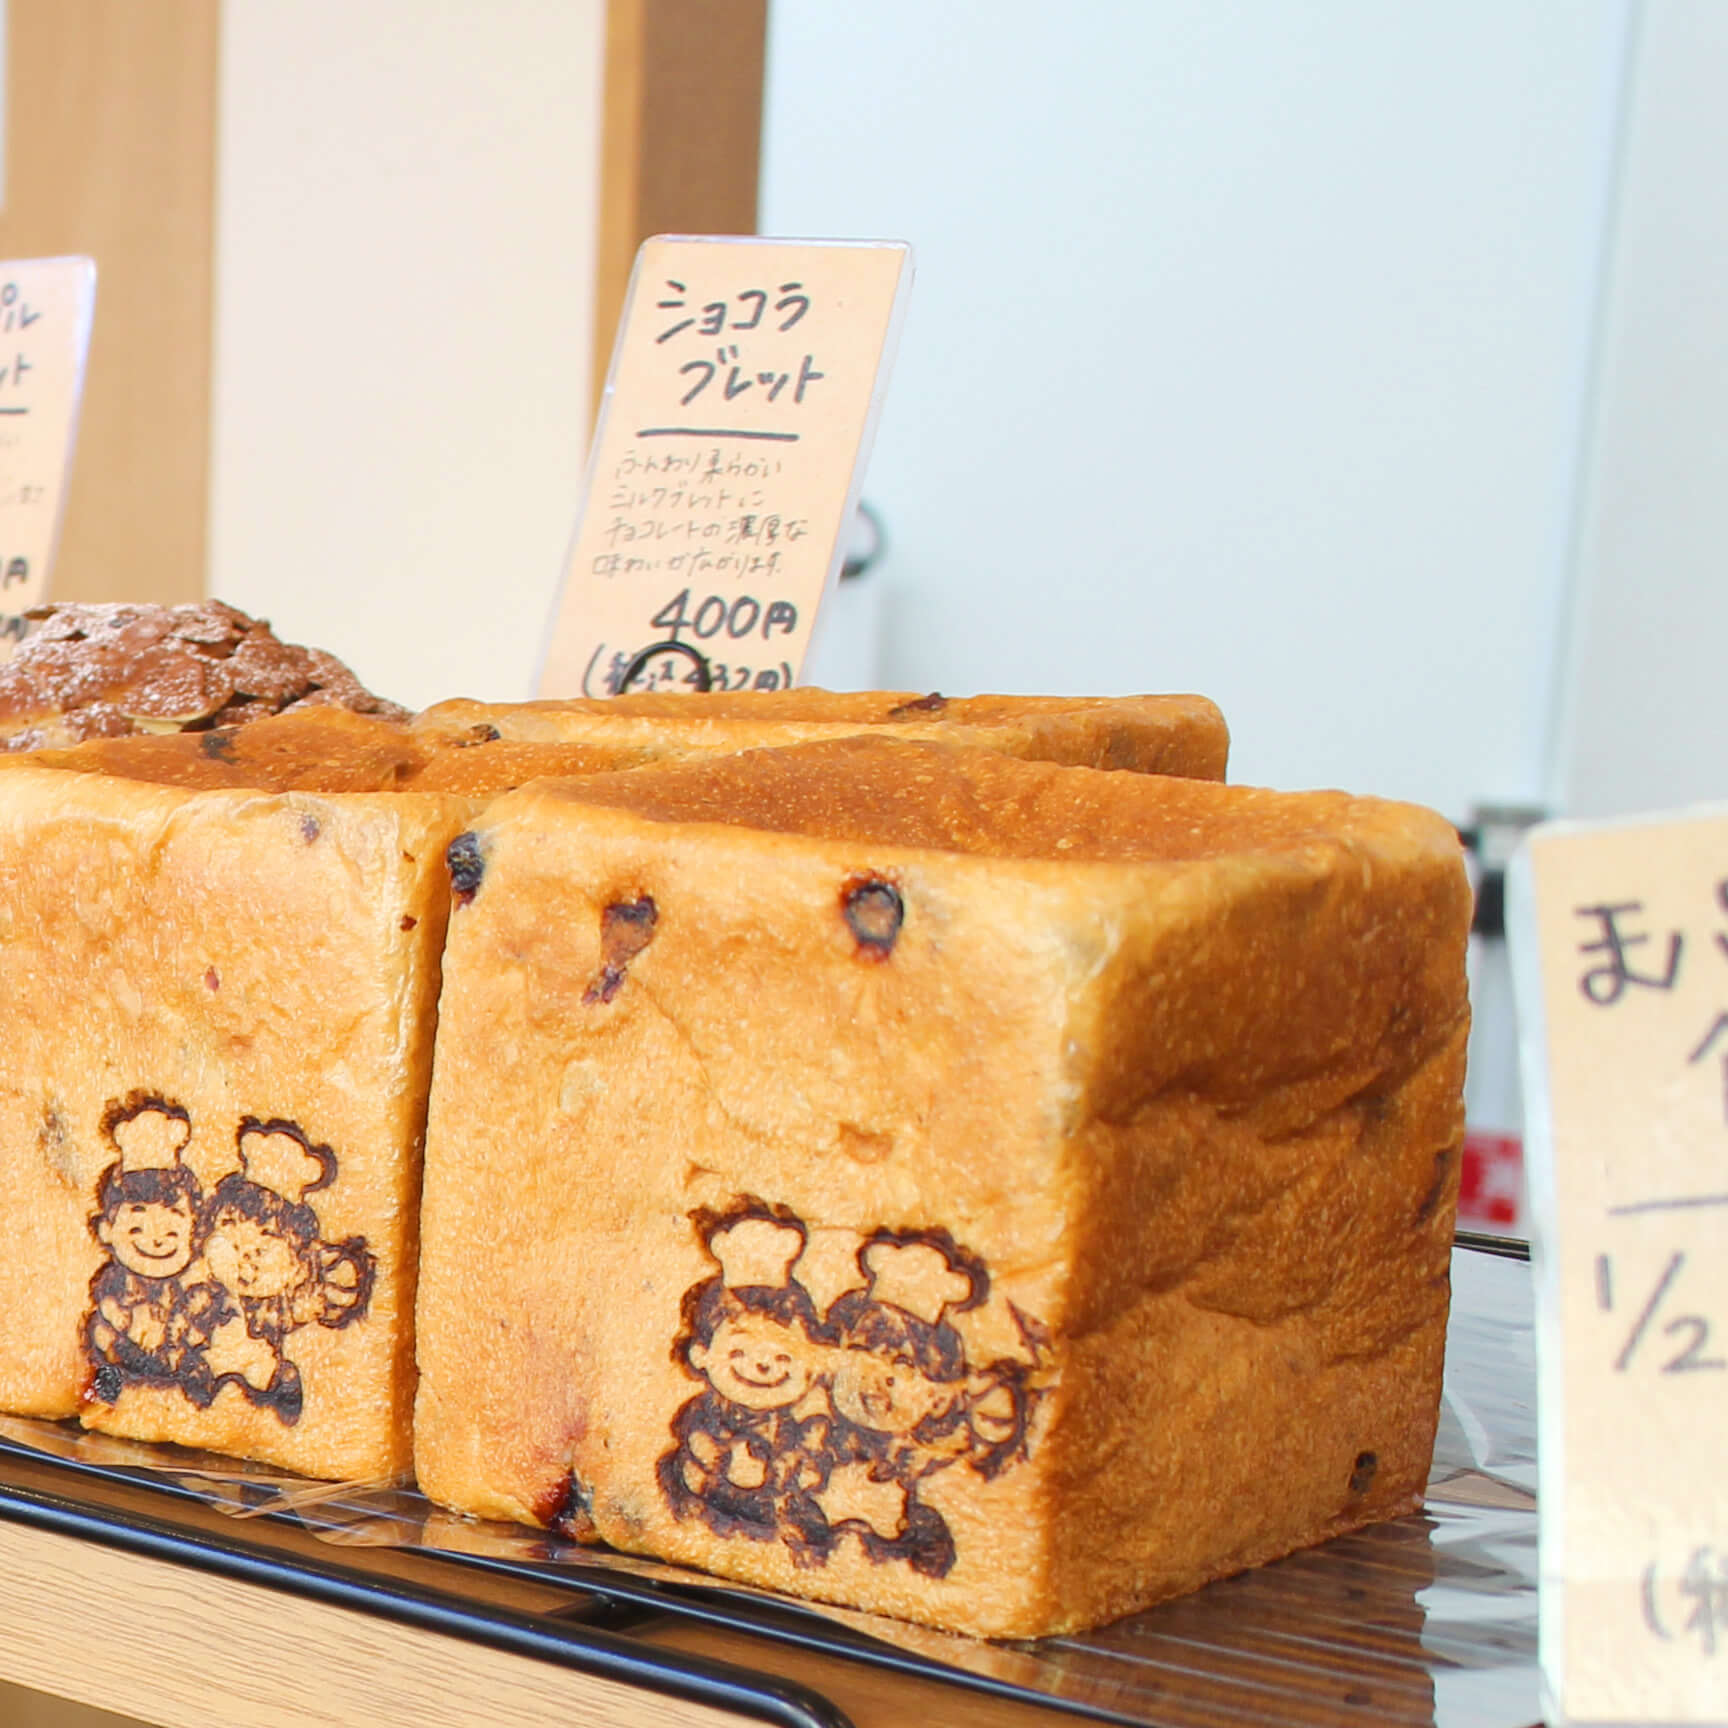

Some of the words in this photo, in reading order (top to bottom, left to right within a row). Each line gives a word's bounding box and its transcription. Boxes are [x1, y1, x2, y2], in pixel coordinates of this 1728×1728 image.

[656, 280, 811, 345] ショコラ
[679, 344, 825, 407] ブレット
[614, 447, 784, 485] ふんわり柔らかい
[649, 587, 799, 643] 400円
